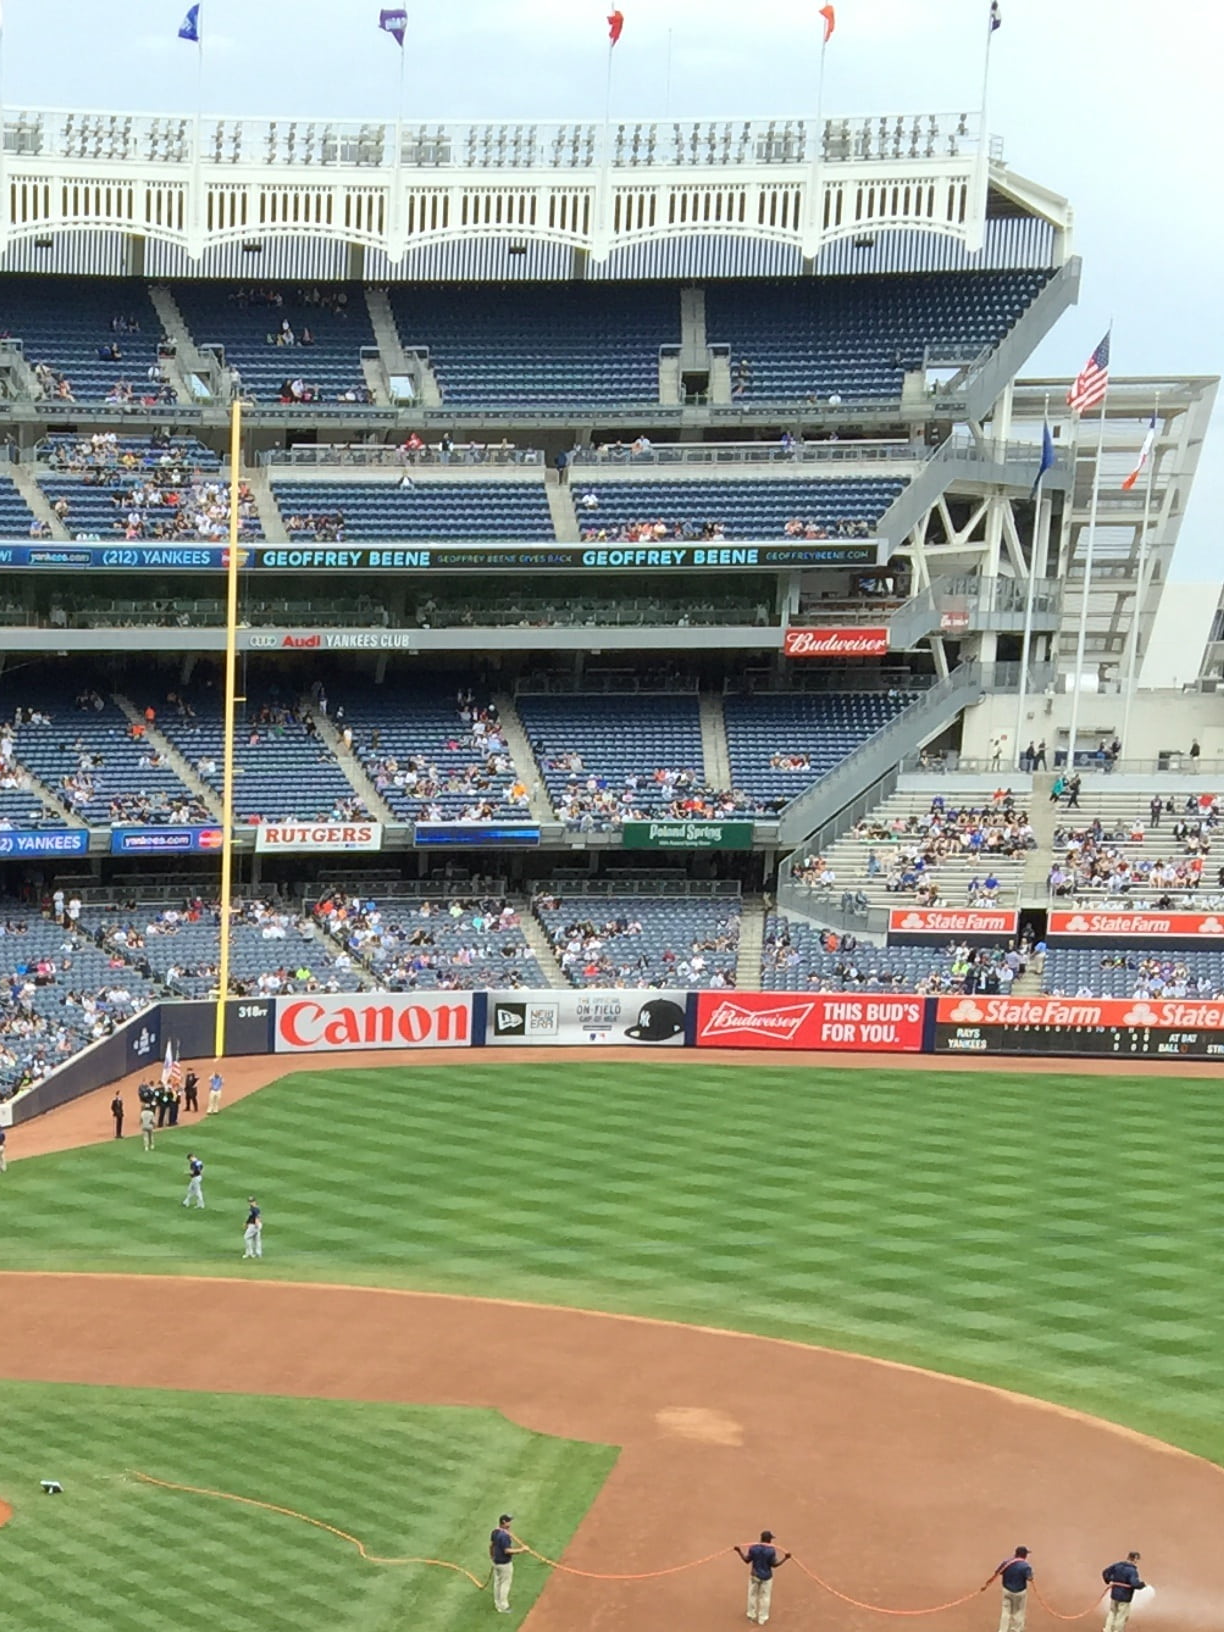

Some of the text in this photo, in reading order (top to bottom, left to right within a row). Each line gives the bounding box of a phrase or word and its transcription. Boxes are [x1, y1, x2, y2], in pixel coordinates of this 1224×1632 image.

[102, 550, 138, 566] (212)
[143, 550, 210, 565] YANKEES
[263, 550, 362, 567] GEOFFREY
[369, 550, 431, 567] BEENE
[582, 548, 759, 566] GEOFFREY BEENE
[281, 634, 410, 648] Audi YANKEES CLUB
[787, 631, 887, 653] Budweiser
[264, 827, 372, 844] RUTGERS
[649, 824, 723, 841] Poland Spring
[17, 836, 81, 851] YANKEES
[530, 1009, 554, 1019] NEW
[712, 1009, 801, 1028] Budweiser
[823, 1003, 920, 1023] THIS BUD'S
[279, 1001, 468, 1046] Canon
[530, 1019, 554, 1029] ERA
[821, 1024, 901, 1043] FOR YOU.
